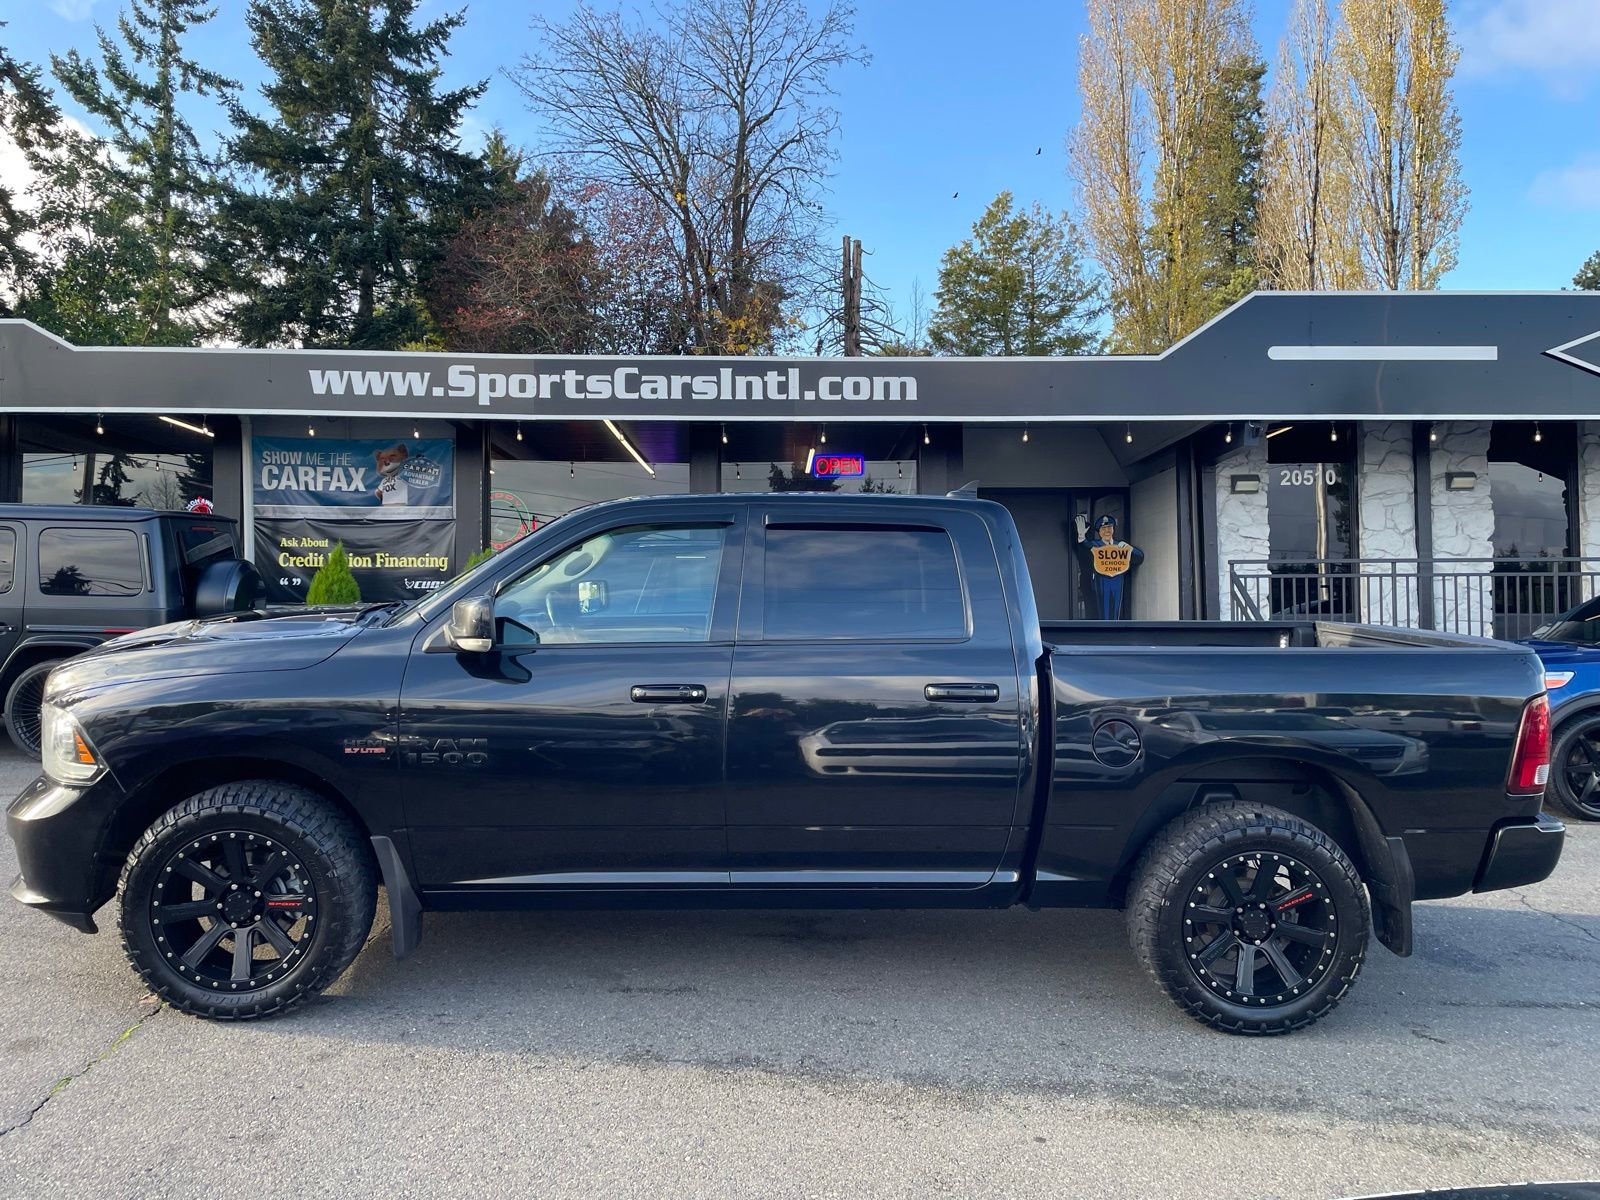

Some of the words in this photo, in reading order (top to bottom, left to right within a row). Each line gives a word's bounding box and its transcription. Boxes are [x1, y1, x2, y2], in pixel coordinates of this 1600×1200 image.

[308, 364, 919, 406] www.SportsCarsIntl.com
[262, 451, 302, 465] SHOW
[306, 452, 325, 466] ME
[329, 452, 352, 466] THE
[816, 457, 862, 475] OPEN
[261, 465, 367, 492] CARFAX
[408, 477, 429, 486] DEALER
[1280, 469, 1336, 486] 20510
[280, 537, 299, 548] Ask
[300, 537, 329, 548] About
[278, 552, 325, 568] Credit
[375, 552, 448, 571] Financing
[1098, 550, 1128, 559] SLOW
[407, 752, 488, 764] 1500
